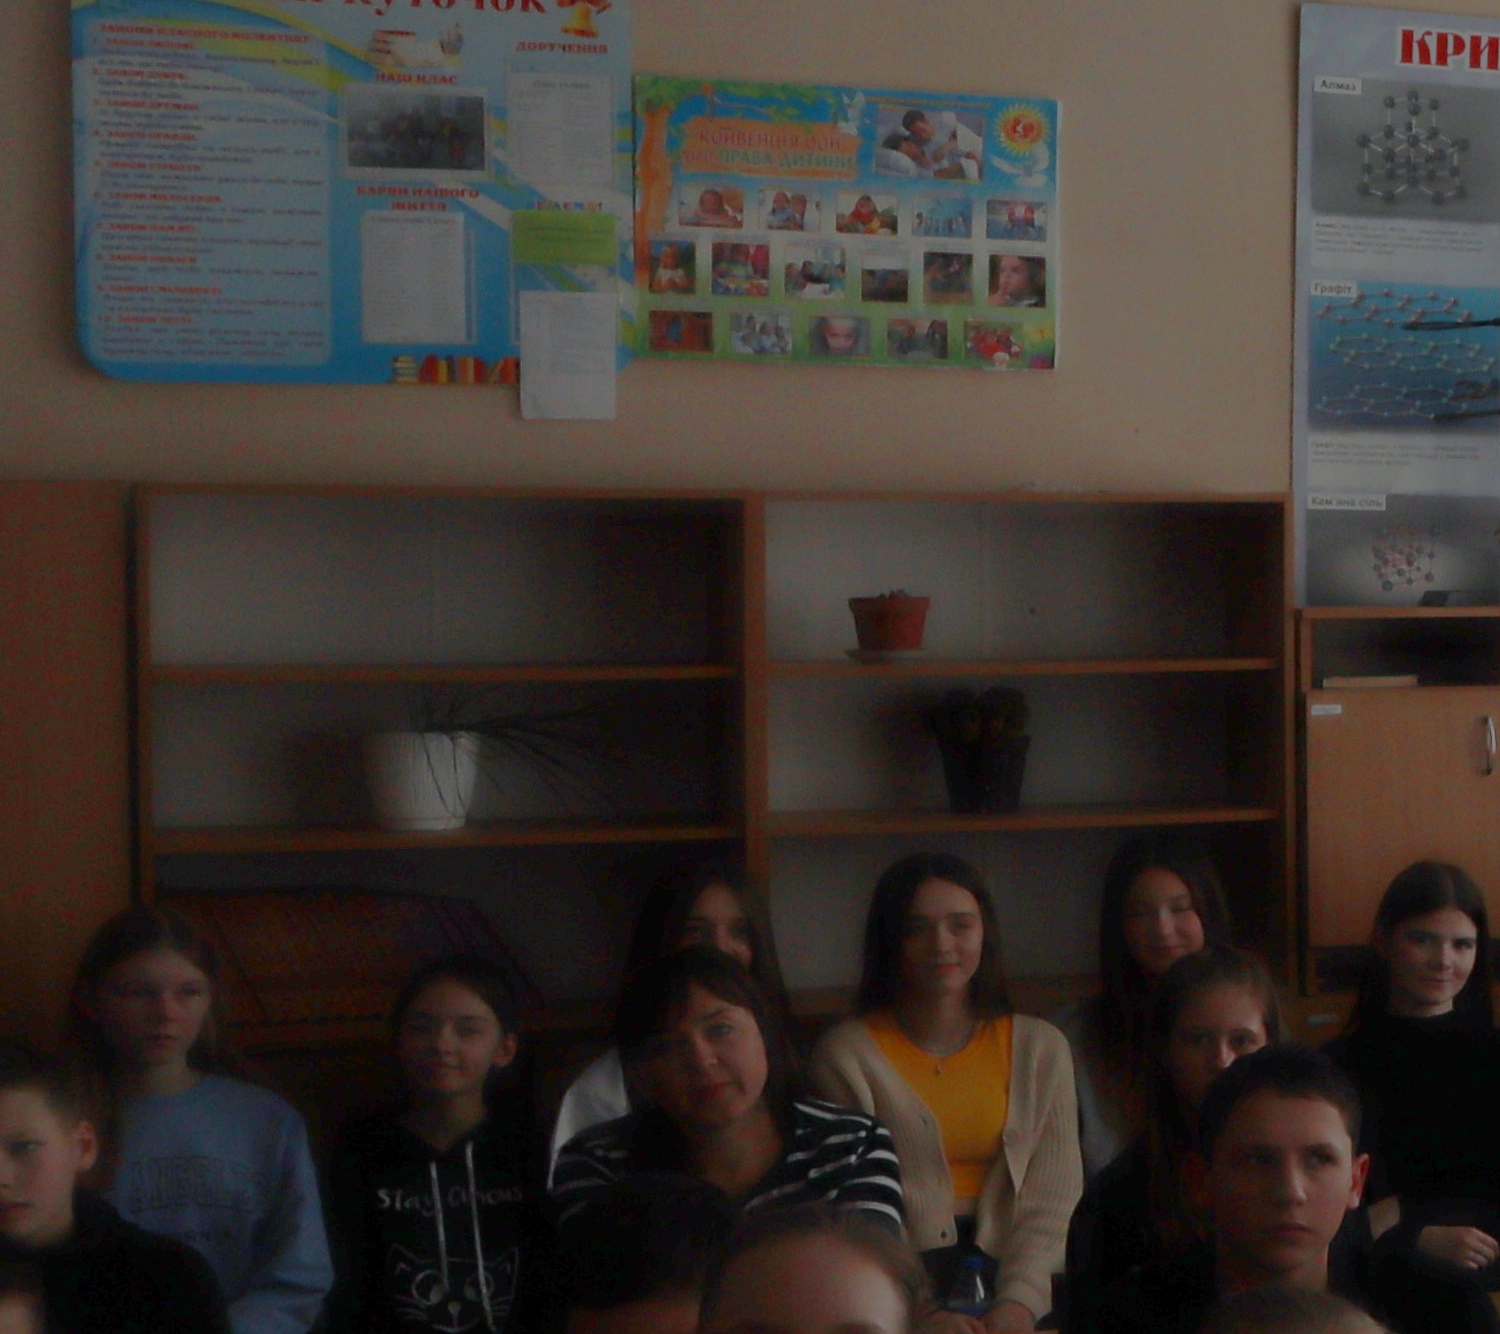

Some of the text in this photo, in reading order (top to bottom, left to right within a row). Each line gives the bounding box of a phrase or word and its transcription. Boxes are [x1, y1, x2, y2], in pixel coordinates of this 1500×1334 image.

[516, 40, 608, 55] ДОРУЧЕННЯ
[376, 72, 457, 85] НАШ КЛАС
[1320, 79, 1356, 90] Алмаз
[699, 128, 841, 151] КОНВЕНЦІЯ ООН
[720, 149, 773, 166] ПРАВА
[778, 153, 852, 169] ДИТИНИ
[412, 187, 480, 198] НАШОГО
[1314, 282, 1353, 295] Графіт
[377, 1188, 436, 1217] Stay
